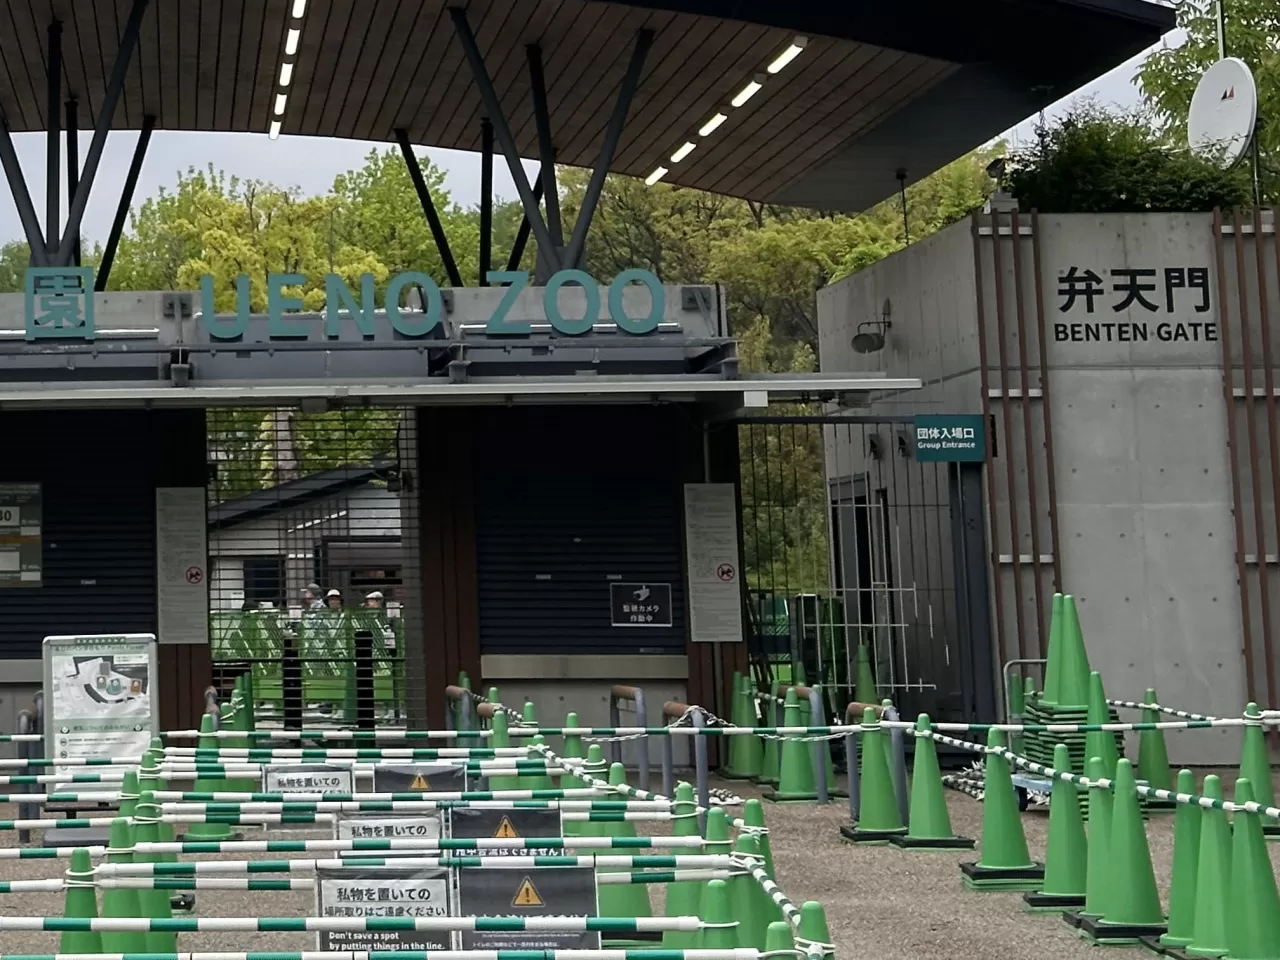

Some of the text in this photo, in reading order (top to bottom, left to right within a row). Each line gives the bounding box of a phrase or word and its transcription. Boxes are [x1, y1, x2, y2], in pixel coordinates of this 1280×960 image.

[1058, 266, 1210, 313] 弁天門
[200, 268, 666, 339] UENO ZOO
[1054, 322, 1218, 341] BENTEN GATE
[917, 427, 975, 439] 団体入場口
[918, 441, 976, 450] Group Entrance
[278, 777, 340, 788] 私物を置いての
[351, 825, 427, 837] 私物を置いての
[337, 888, 431, 900] 私物を置いての
[324, 906, 446, 917] 場所取りはご遠慮ください
[329, 932, 352, 940] Don't
[380, 932, 399, 941] spot
[329, 942, 445, 951] by putting things in the line.
